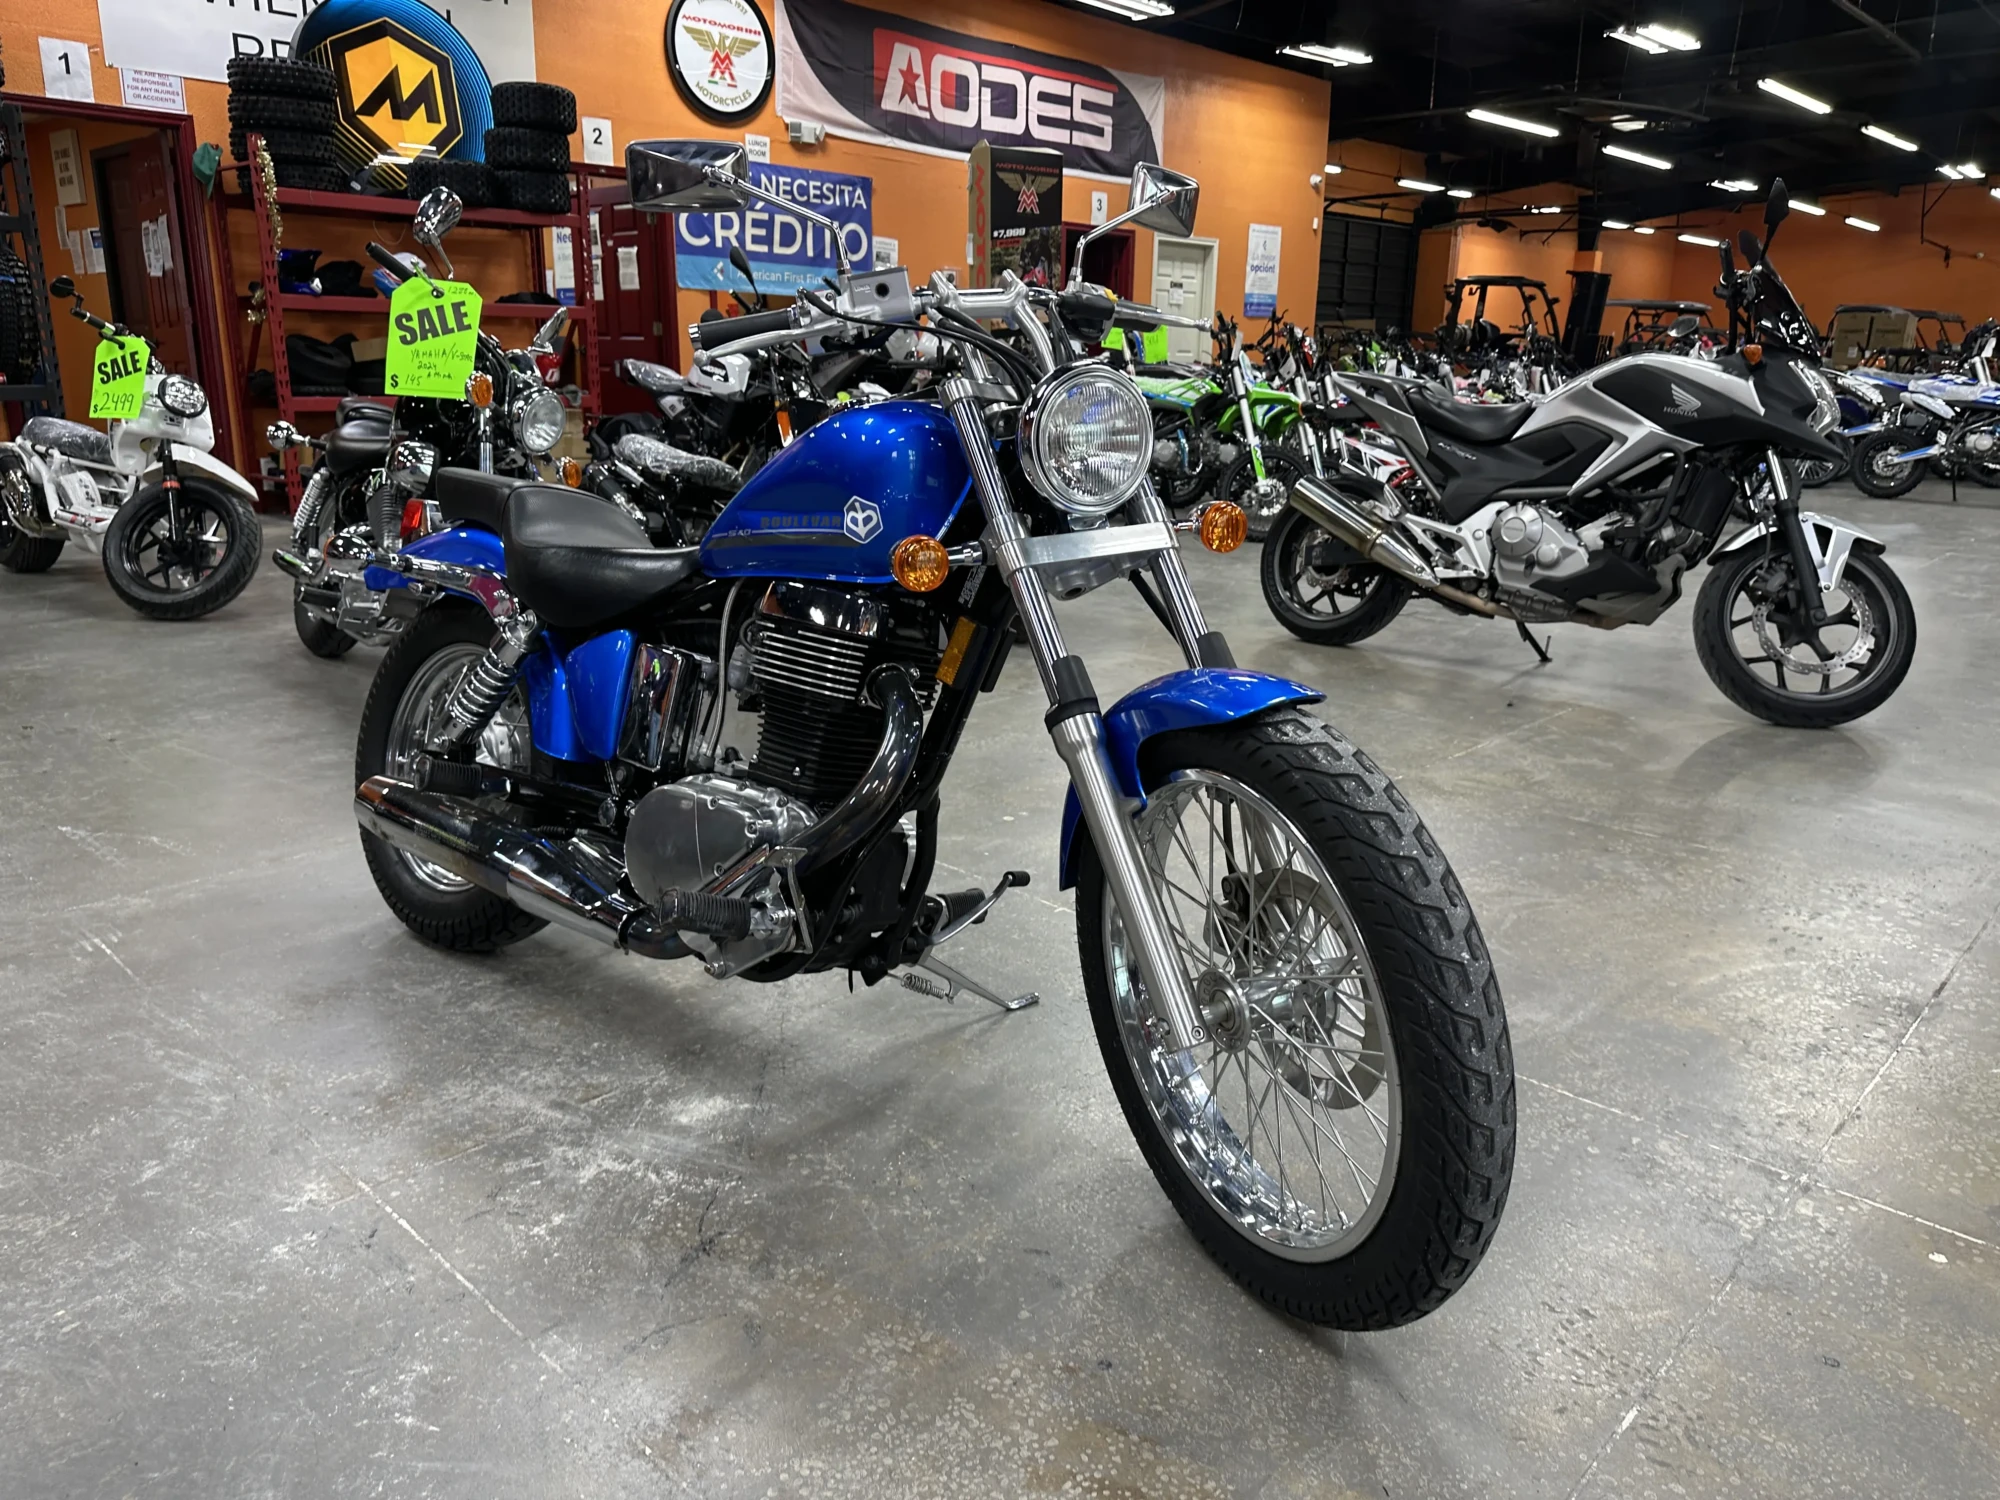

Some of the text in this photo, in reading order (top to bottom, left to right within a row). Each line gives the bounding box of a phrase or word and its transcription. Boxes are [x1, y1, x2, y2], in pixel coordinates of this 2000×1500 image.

[58, 52, 71, 75] 1
[132, 77, 173, 88] RESPONSIBLE
[142, 94, 176, 104] ACCIDENTS
[153, 89, 180, 97] INJURIES
[695, 81, 753, 107] MOTORCYCLES
[881, 42, 1114, 152] AODES
[592, 127, 603, 145] 2
[748, 139, 768, 149] LUNCH
[748, 148, 767, 158] ROOM
[996, 162, 1024, 170] MOTO
[761, 173, 868, 210] NECESITA
[1096, 198, 1103, 211] 3
[784, 271, 804, 284] First
[395, 300, 472, 346] SALE
[97, 351, 142, 385] SALE
[390, 374, 399, 388] $
[405, 374, 421, 386] 145
[99, 392, 135, 413] 2499
[1663, 406, 1698, 419] HONDA
